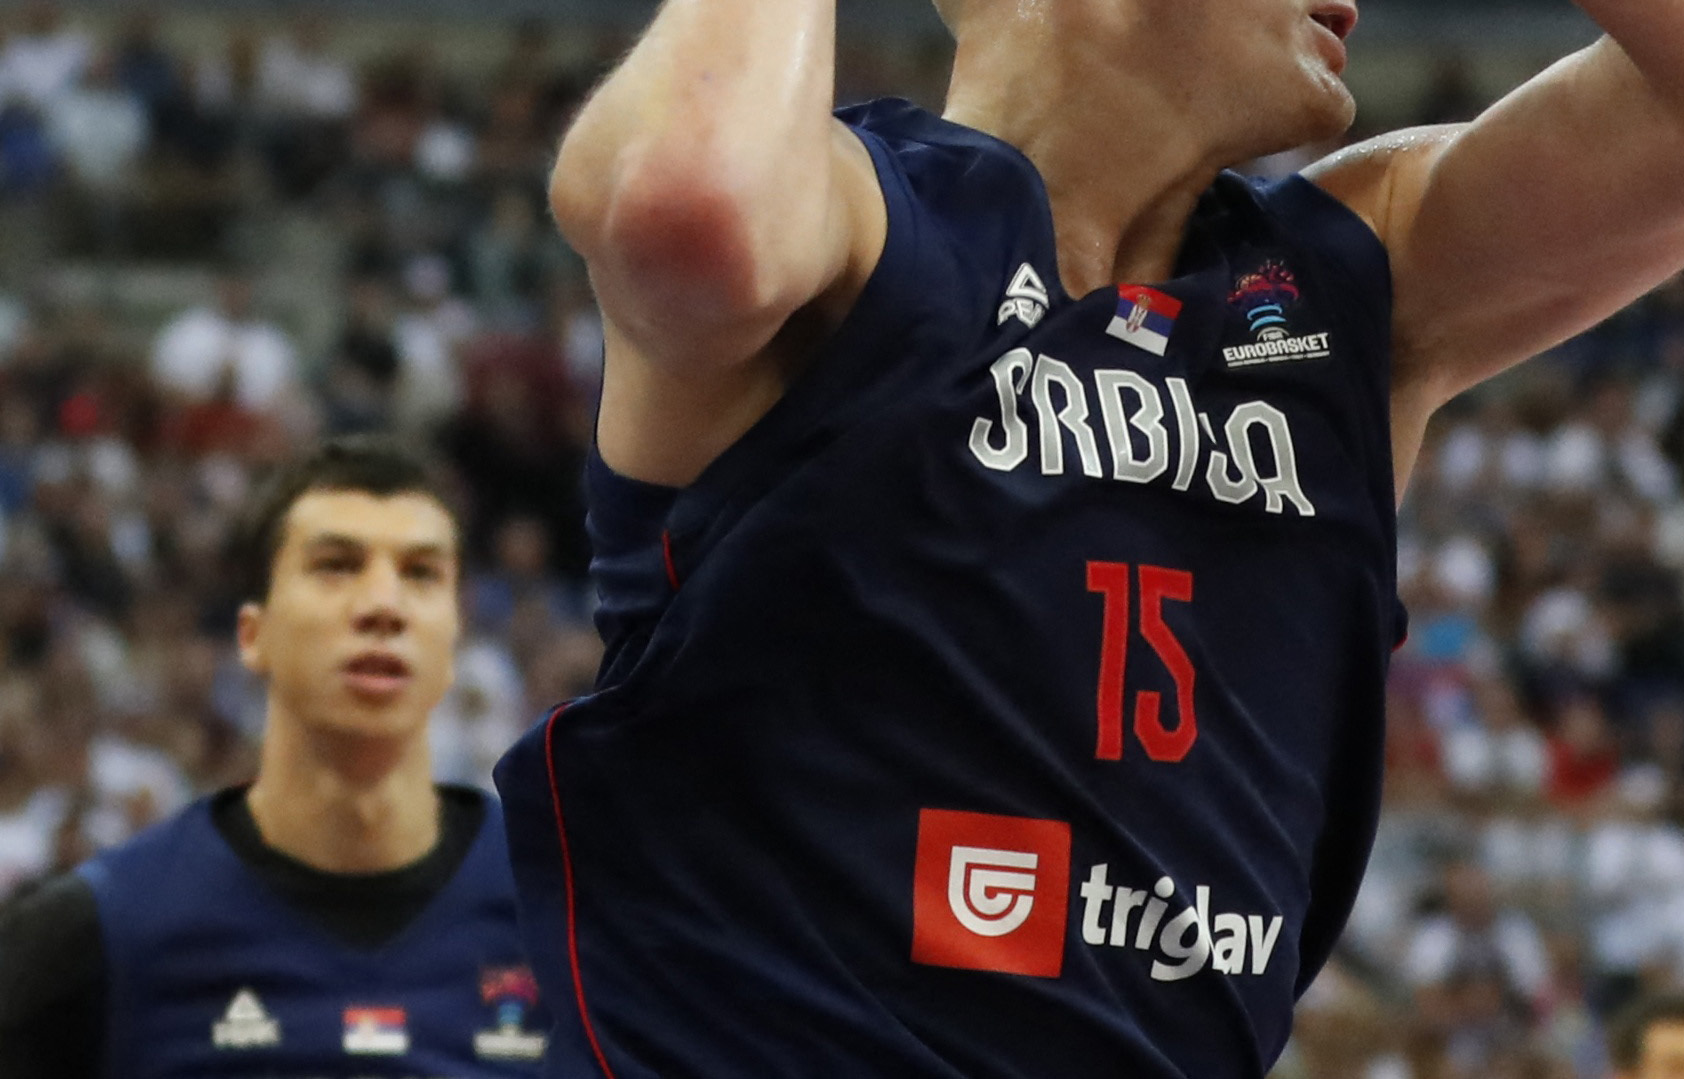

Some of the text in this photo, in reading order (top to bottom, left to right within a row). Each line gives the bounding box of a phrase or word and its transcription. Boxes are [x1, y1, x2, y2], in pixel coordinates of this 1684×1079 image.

[1222, 332, 1329, 362] EUROBASKET
[968, 347, 1315, 517] SRBIJA
[1086, 560, 1198, 763] 15
[1080, 863, 1284, 982] triglav
